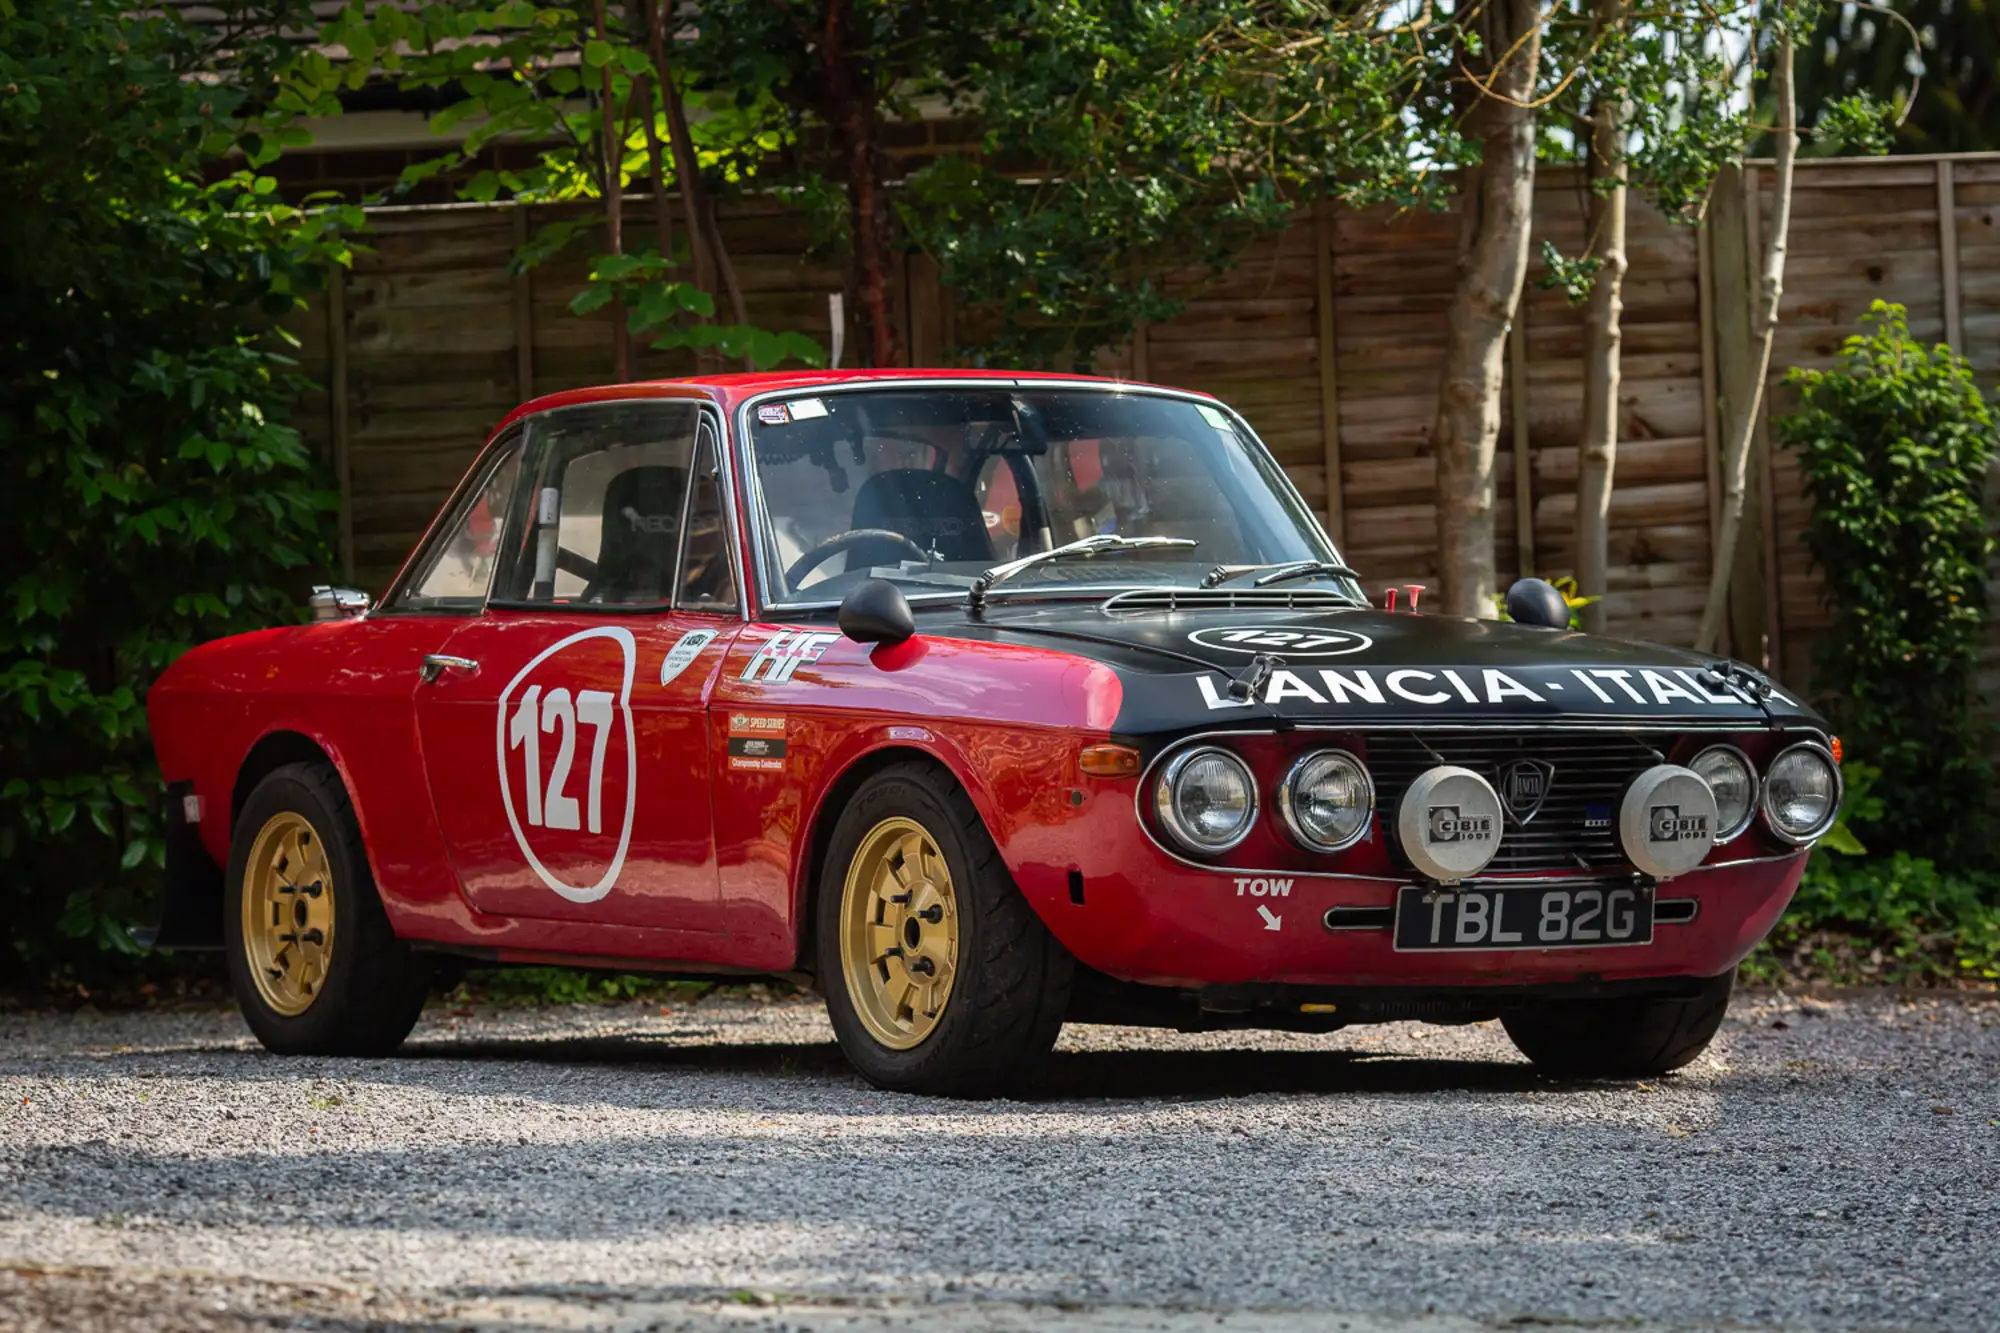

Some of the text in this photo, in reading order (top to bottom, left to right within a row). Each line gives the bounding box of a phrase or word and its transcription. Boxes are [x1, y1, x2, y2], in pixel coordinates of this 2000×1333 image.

[739, 629, 842, 685] HF
[1220, 630, 1351, 649] 127
[1196, 668, 1547, 709] LANCIA
[750, 717, 785, 729] SPEED SERIES
[510, 685, 615, 834] 127
[1233, 878, 1294, 897] TOW
[1422, 889, 1636, 944] TBL 82G
